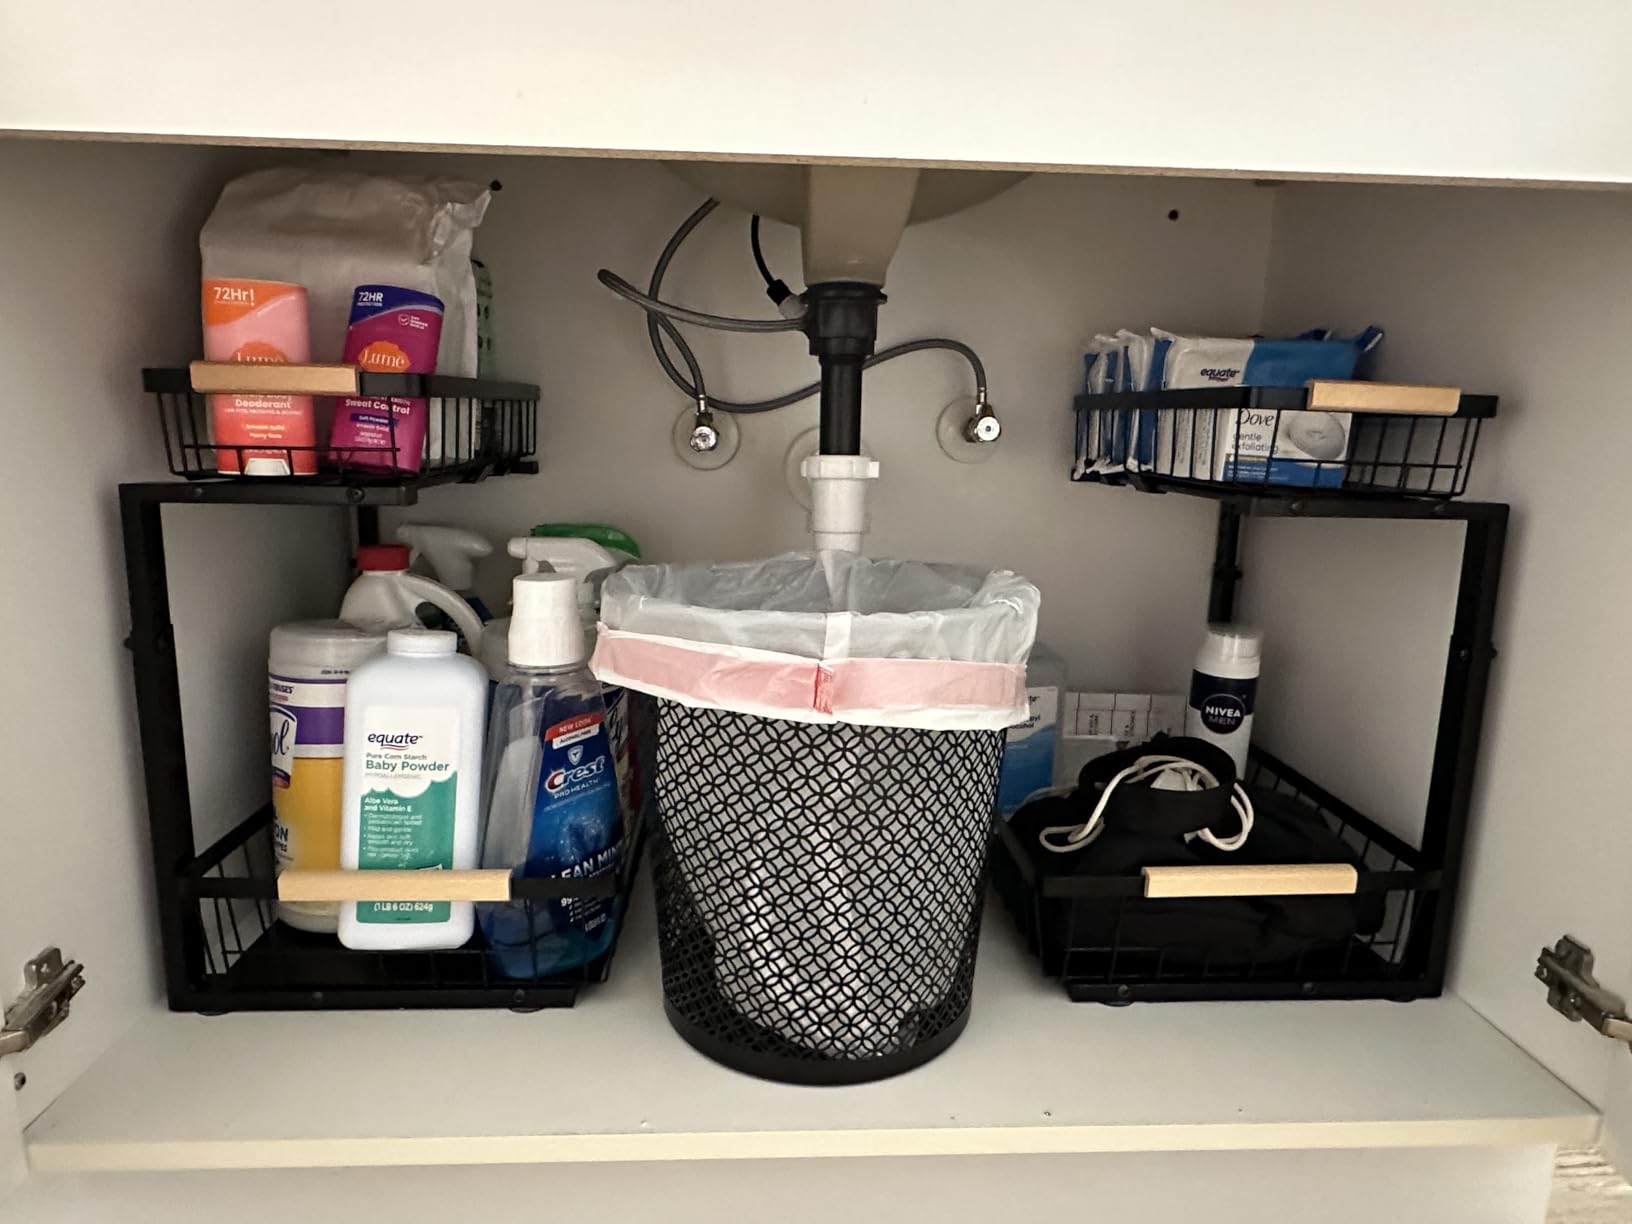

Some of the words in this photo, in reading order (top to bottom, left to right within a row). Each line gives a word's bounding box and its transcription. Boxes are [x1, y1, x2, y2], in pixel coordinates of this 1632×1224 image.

[214, 287, 255, 307] 72Hr!
[359, 292, 383, 302] 72HR
[1200, 369, 1236, 379] equate
[235, 399, 291, 409] Deodorant
[345, 398, 372, 408] Sweat
[1237, 408, 1275, 427] Dove
[1232, 440, 1279, 455] efoliatig
[1205, 705, 1242, 719] NIVEA
[559, 723, 574, 733] NEW
[574, 716, 591, 729] LOOK
[1208, 716, 1238, 727] MEN
[367, 733, 420, 747] equate
[366, 760, 397, 772] Baby
[401, 761, 450, 771] Powder
[544, 754, 606, 794] Crest
[364, 797, 381, 805] Aloe
[551, 857, 594, 878] EAN
[414, 902, 434, 912] 624g
